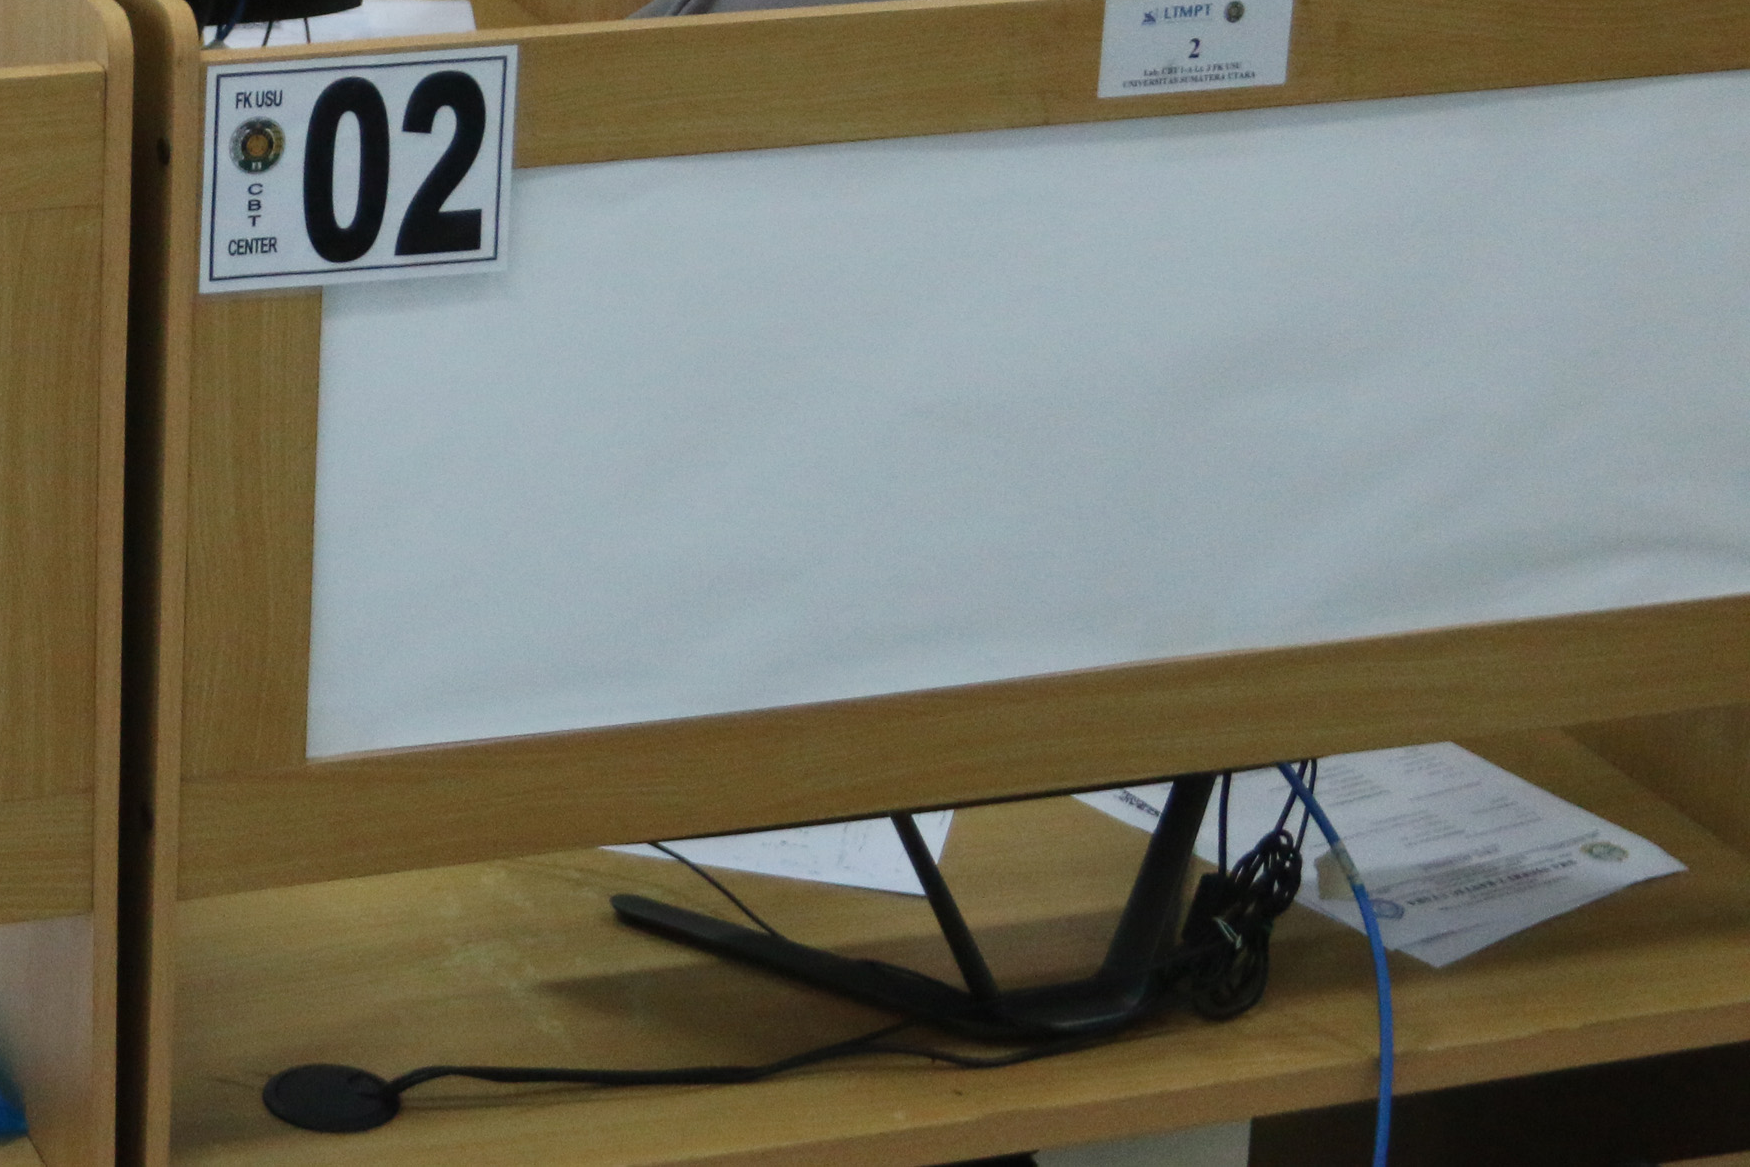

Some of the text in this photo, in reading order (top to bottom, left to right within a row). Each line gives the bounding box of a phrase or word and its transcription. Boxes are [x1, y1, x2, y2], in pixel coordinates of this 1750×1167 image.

[1163, 3, 1214, 20] LTMPT
[1187, 37, 1201, 59] 2
[235, 90, 283, 110] FK USU
[303, 70, 487, 264] 02
[247, 183, 263, 228] CBT
[228, 236, 278, 257] CENTER
